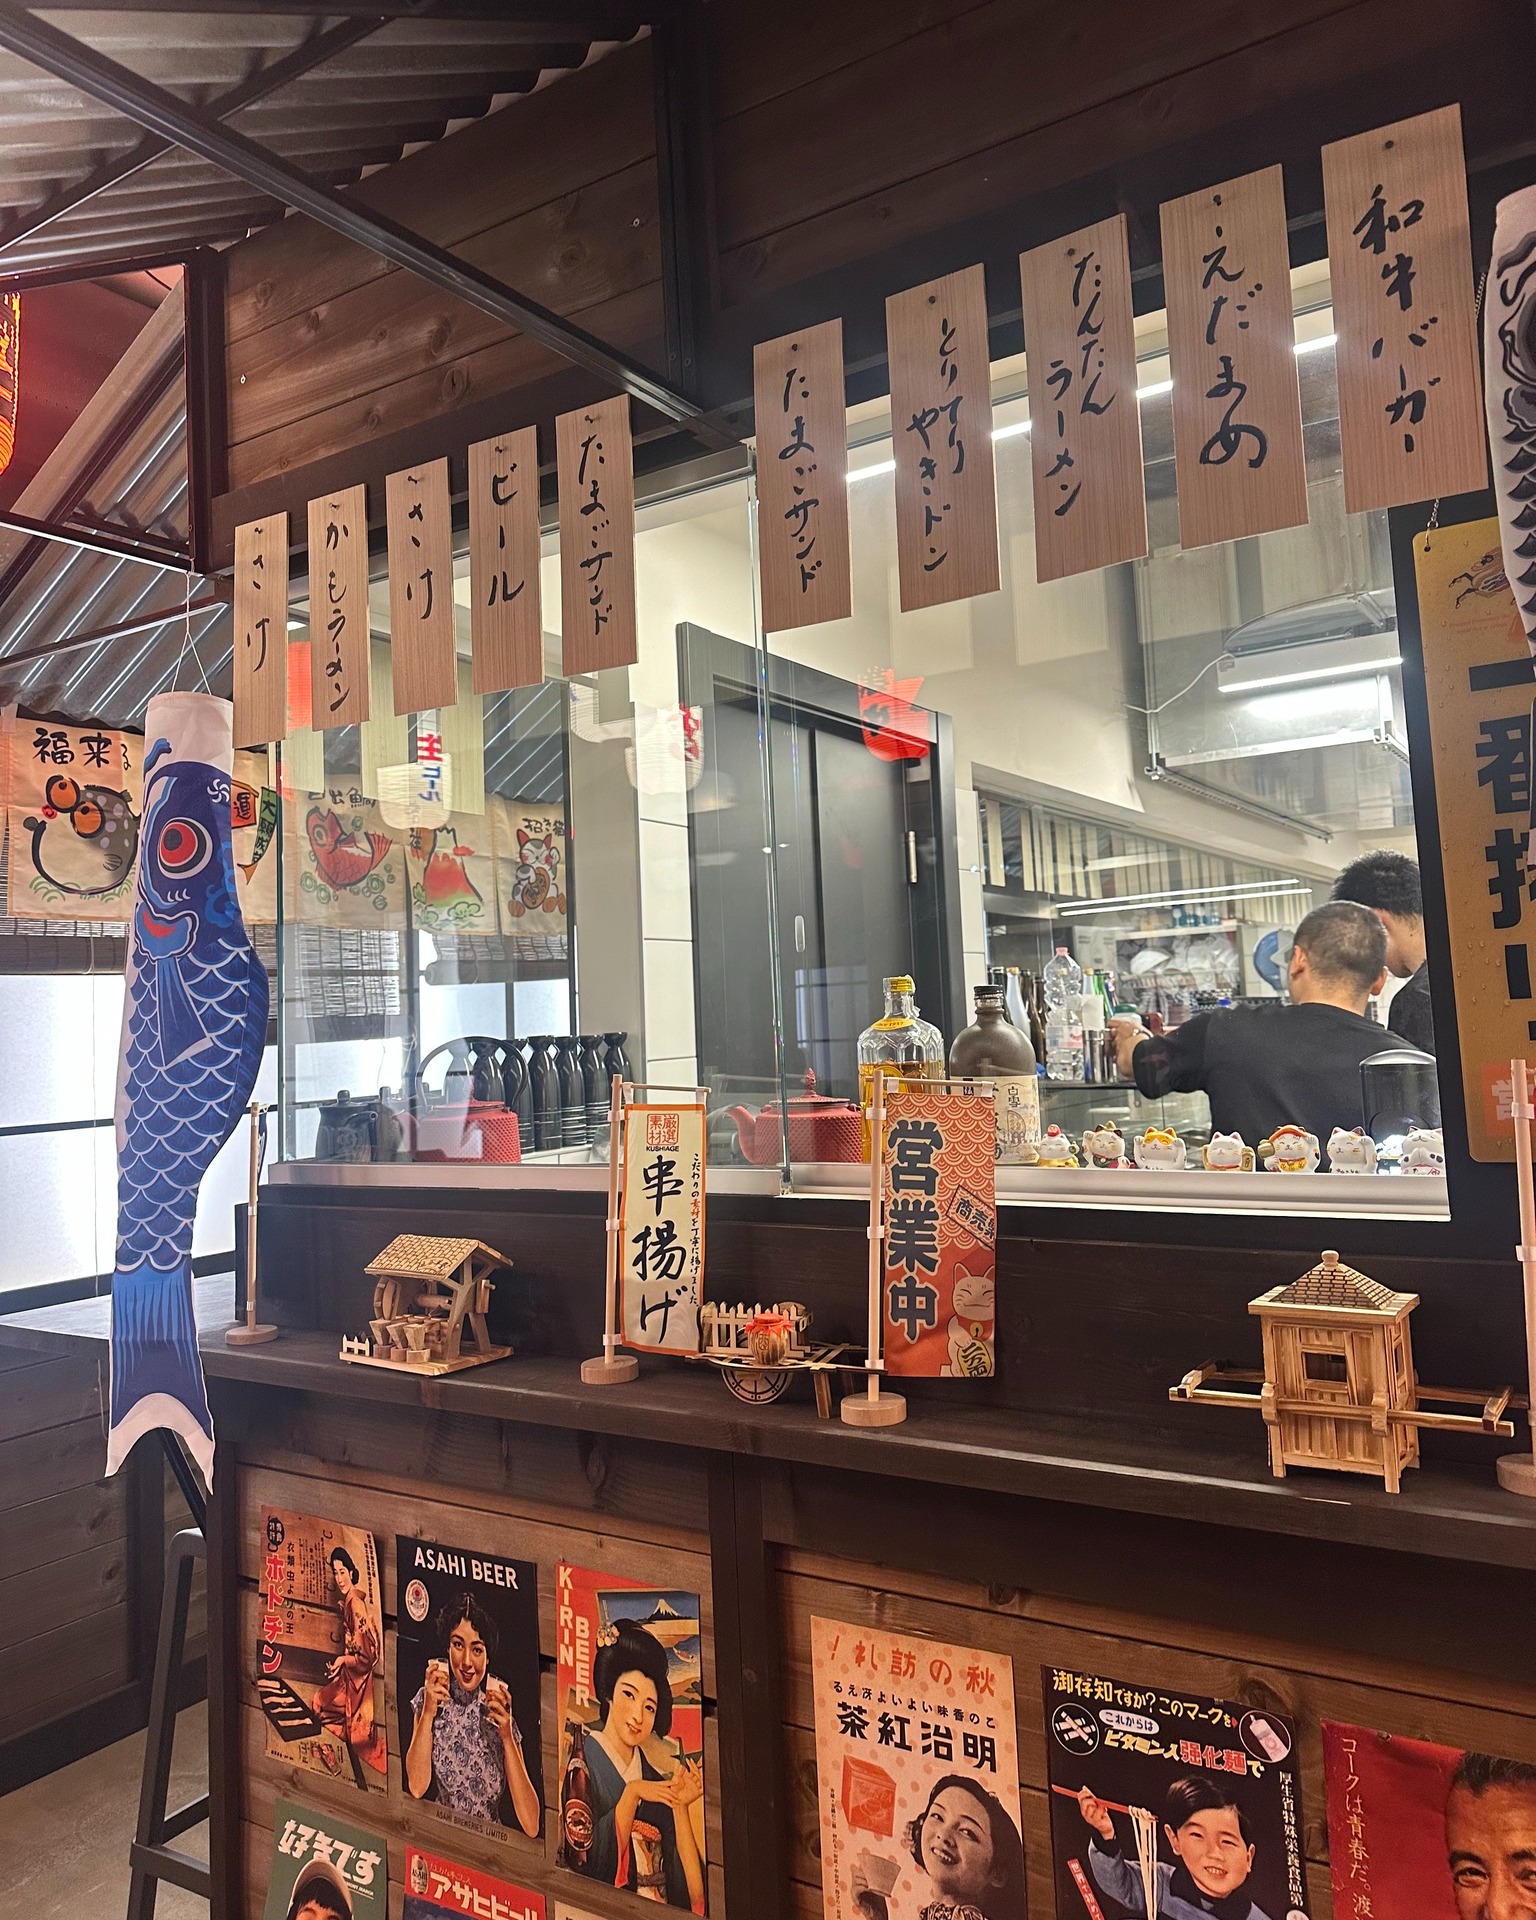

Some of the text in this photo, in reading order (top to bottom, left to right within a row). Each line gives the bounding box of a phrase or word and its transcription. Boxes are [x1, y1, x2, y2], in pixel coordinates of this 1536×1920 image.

[1072, 251, 1118, 416] たんたん
[1200, 225, 1268, 469] えだまめ
[1352, 183, 1442, 453] 和牛バーガー
[779, 367, 823, 593] たまごサンド
[1043, 360, 1082, 517] ラーメン
[247, 553, 271, 672] さけ
[407, 502, 434, 620] さけ
[487, 462, 525, 607] ビール
[578, 433, 613, 636] たまごサンド
[325, 521, 351, 712] かもラーメン
[32, 727, 132, 771] 福来る
[631, 1154, 689, 1345] 串揚げ
[887, 1119, 944, 1342] 営業中
[413, 1546, 467, 1578] ASAHI
[471, 1560, 519, 1590] BEER
[559, 1566, 574, 1667] KIRIN
[575, 1616, 590, 1708] BEER
[486, 1825, 508, 1842] LIMITED
